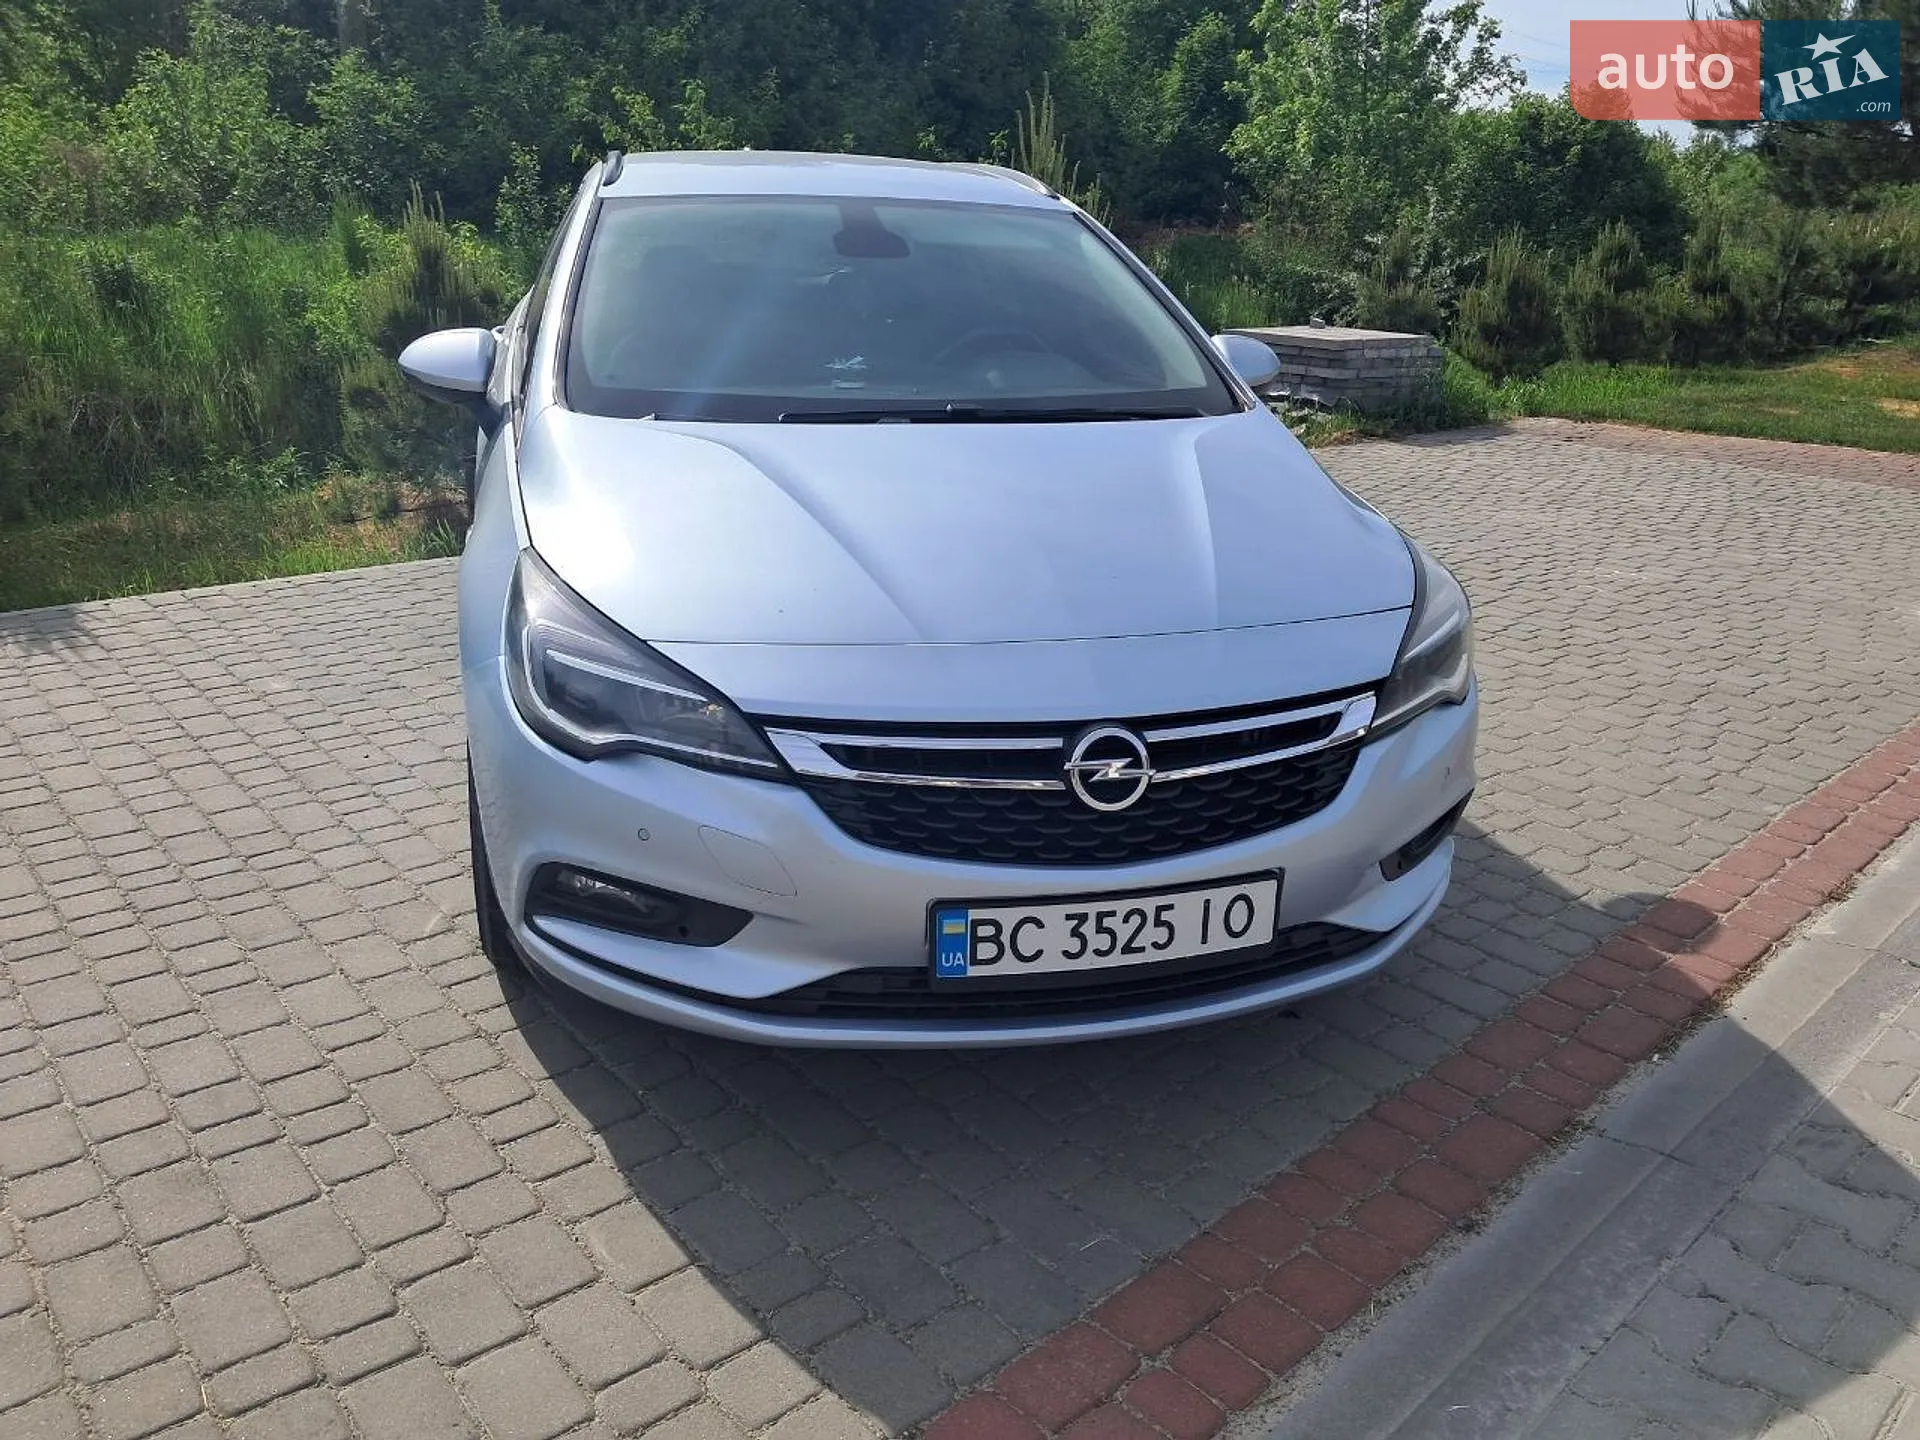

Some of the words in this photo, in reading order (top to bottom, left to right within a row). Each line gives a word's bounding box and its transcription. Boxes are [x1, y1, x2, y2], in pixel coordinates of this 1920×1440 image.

[969, 916, 1045, 967] BC
[1062, 904, 1176, 960] 3525
[1200, 893, 1255, 945] IO
[941, 952, 965, 968] UA
